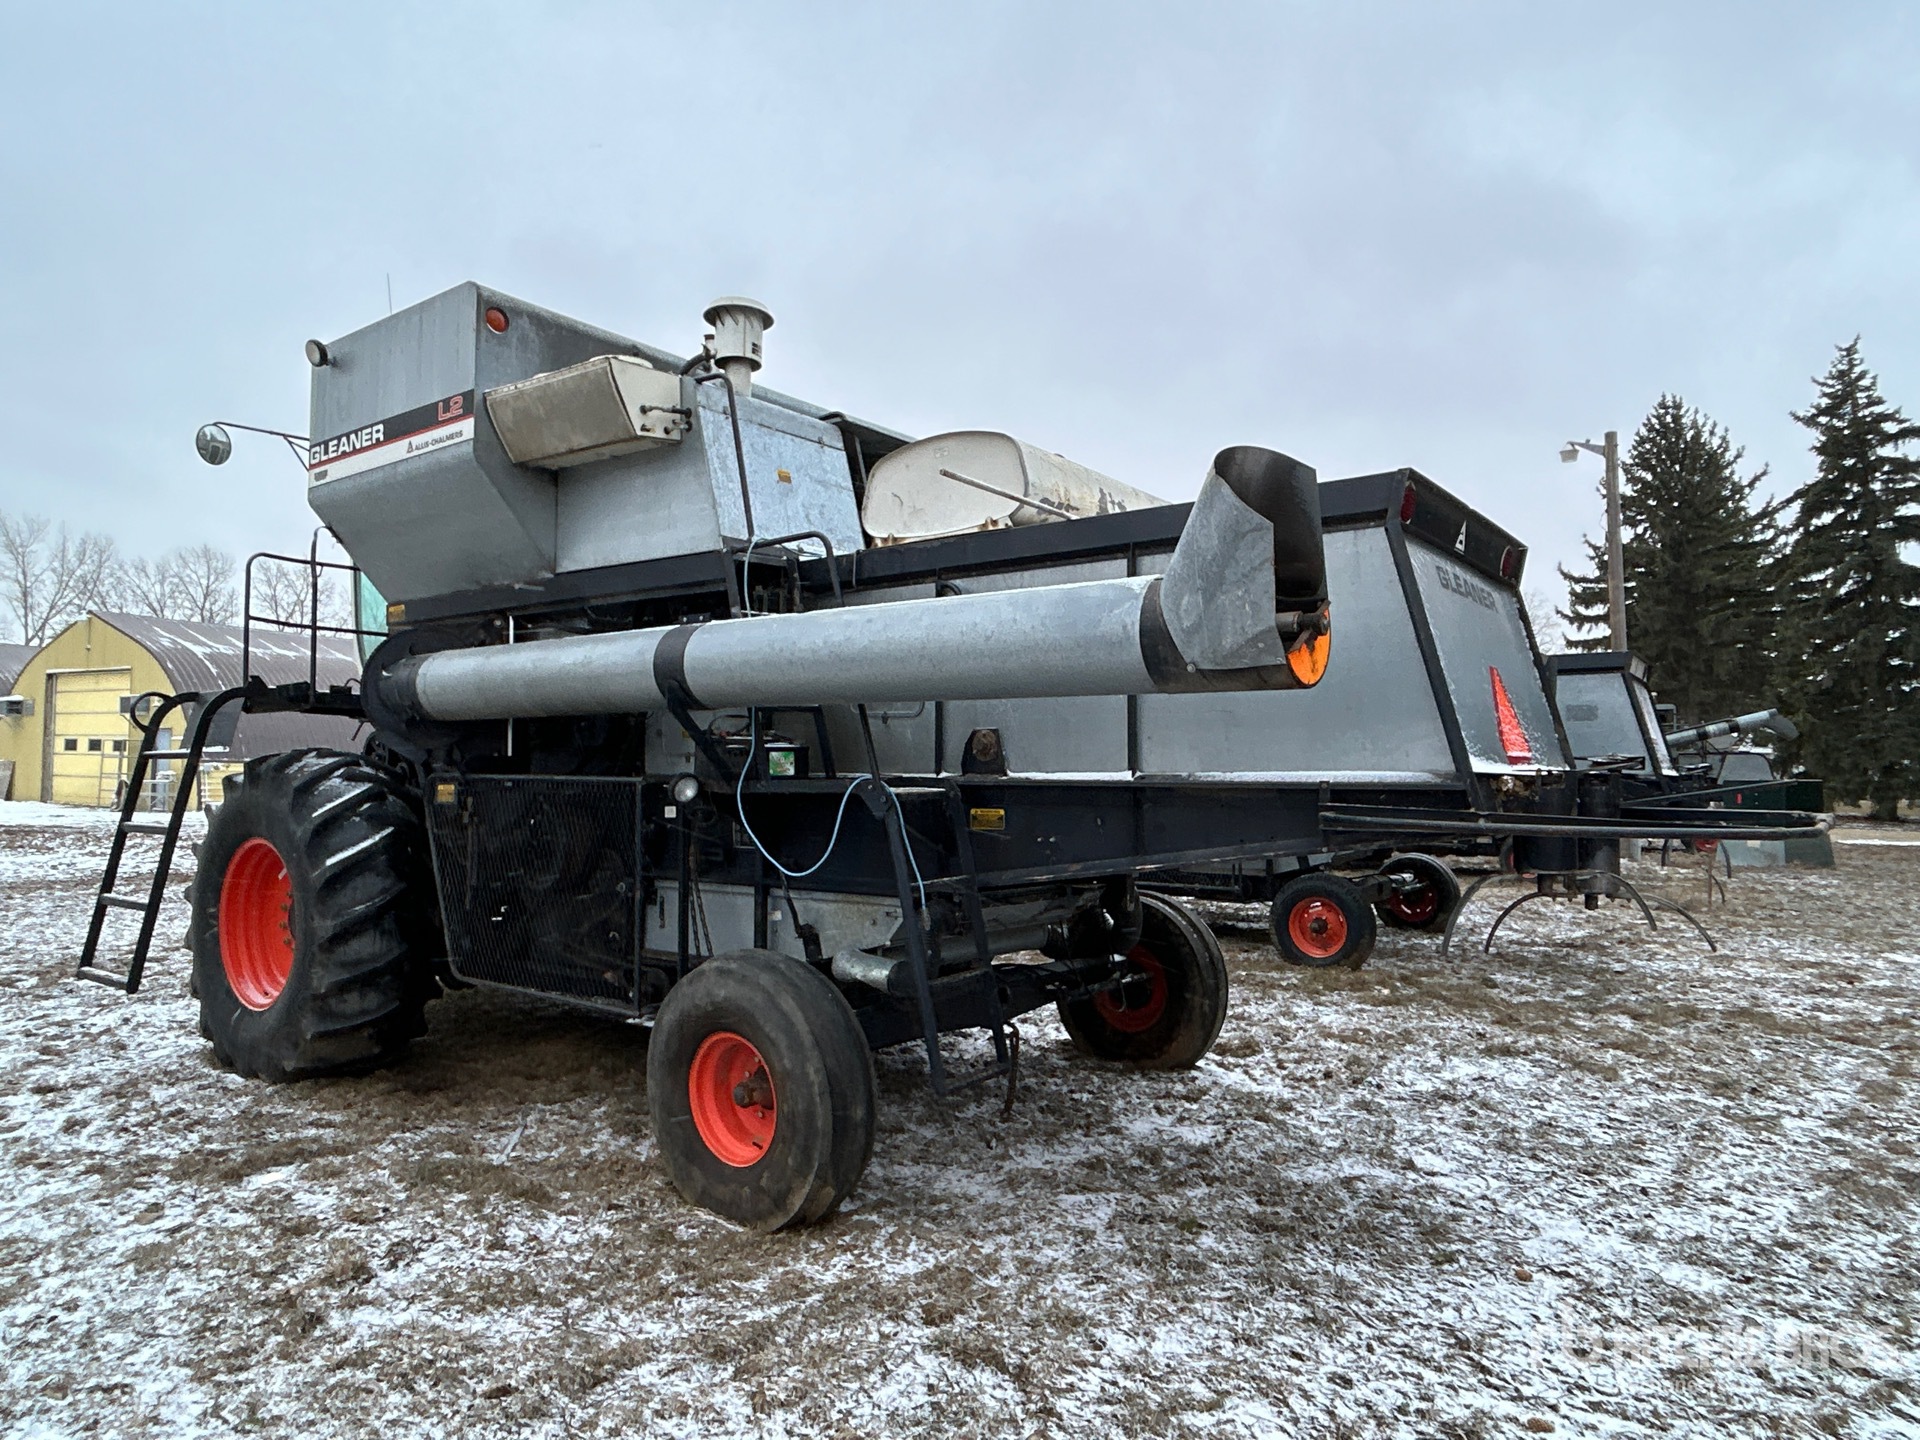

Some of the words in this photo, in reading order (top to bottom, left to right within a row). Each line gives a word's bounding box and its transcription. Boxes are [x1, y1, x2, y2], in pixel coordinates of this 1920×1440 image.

[310, 424, 384, 464] GLEANER
[438, 395, 463, 421] L2
[414, 430, 463, 451] ALLIS-CHALMERS
[1435, 565, 1499, 613] GLEANER
